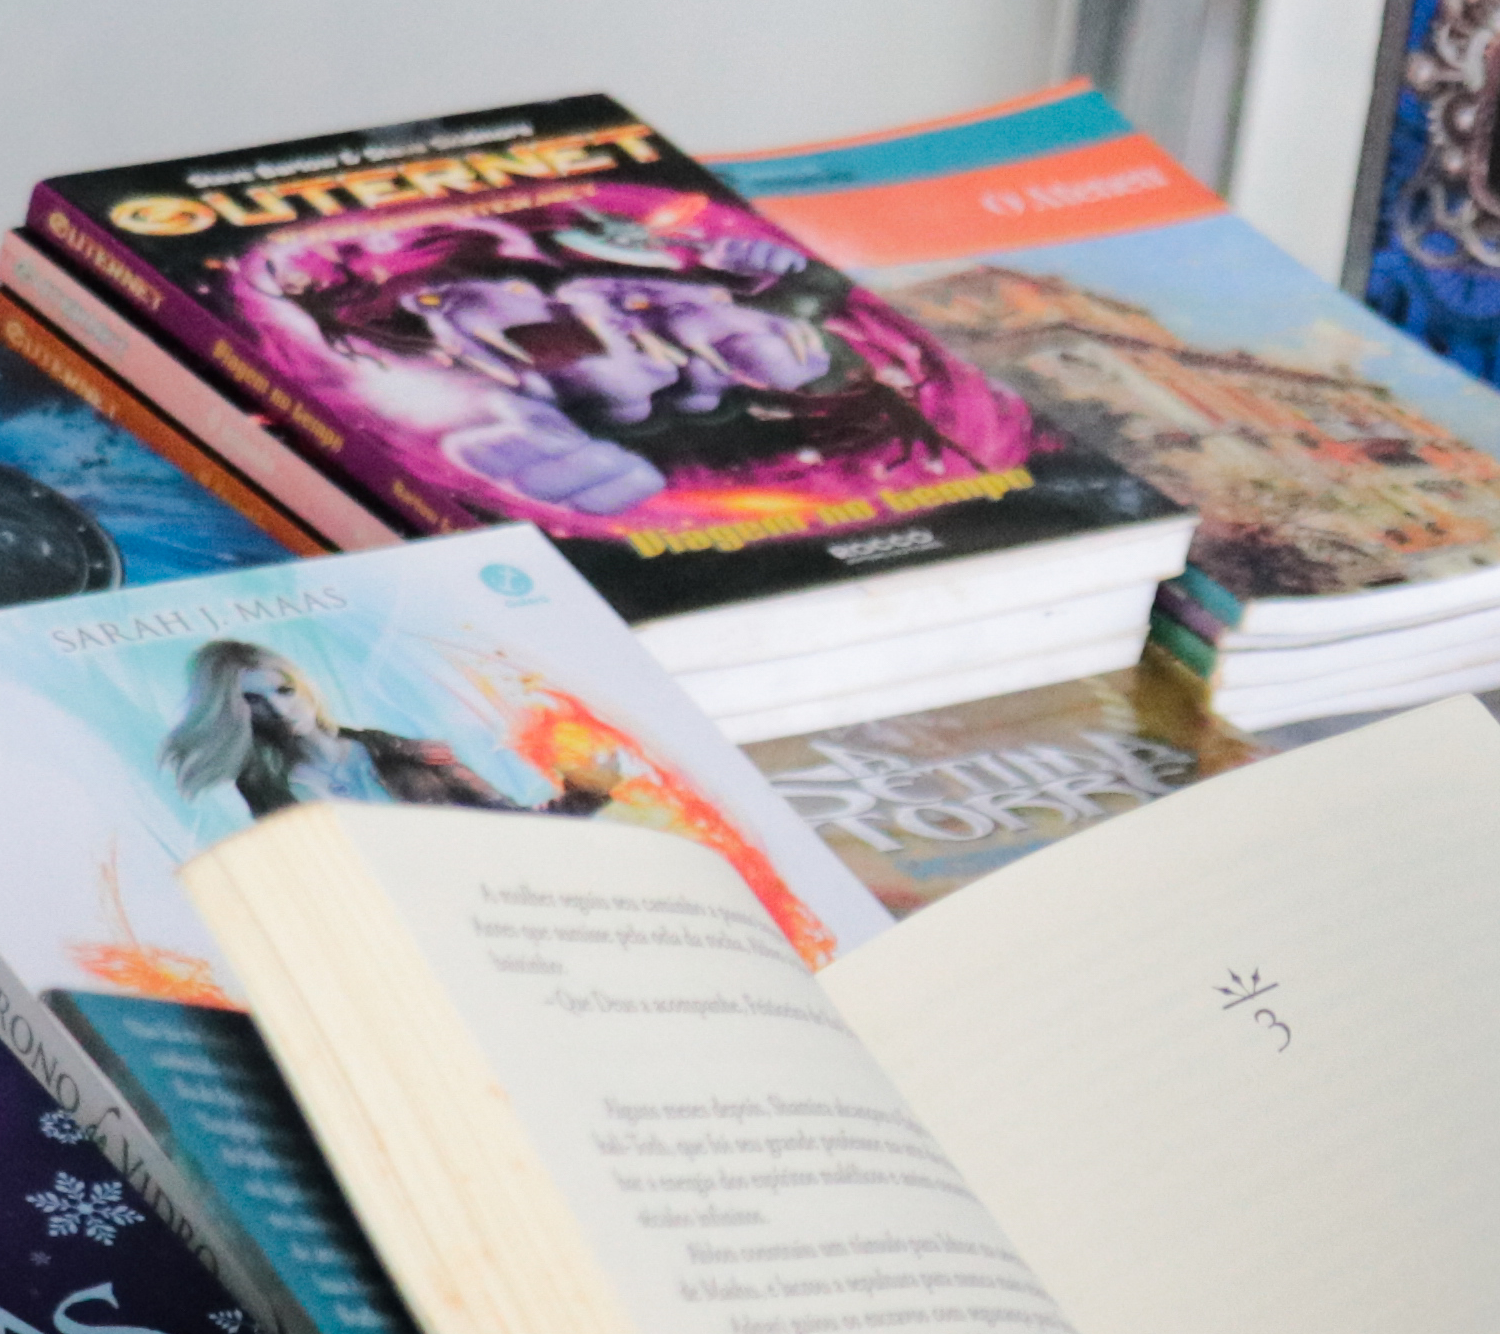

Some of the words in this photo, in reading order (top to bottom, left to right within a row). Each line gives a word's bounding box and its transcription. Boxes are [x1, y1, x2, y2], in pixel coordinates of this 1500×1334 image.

[110, 124, 661, 236] OUTERNET
[52, 607, 198, 656] SARAH
[201, 599, 231, 634] J.
[237, 584, 351, 625] MAAS
[1254, 1008, 1292, 1054] 3
